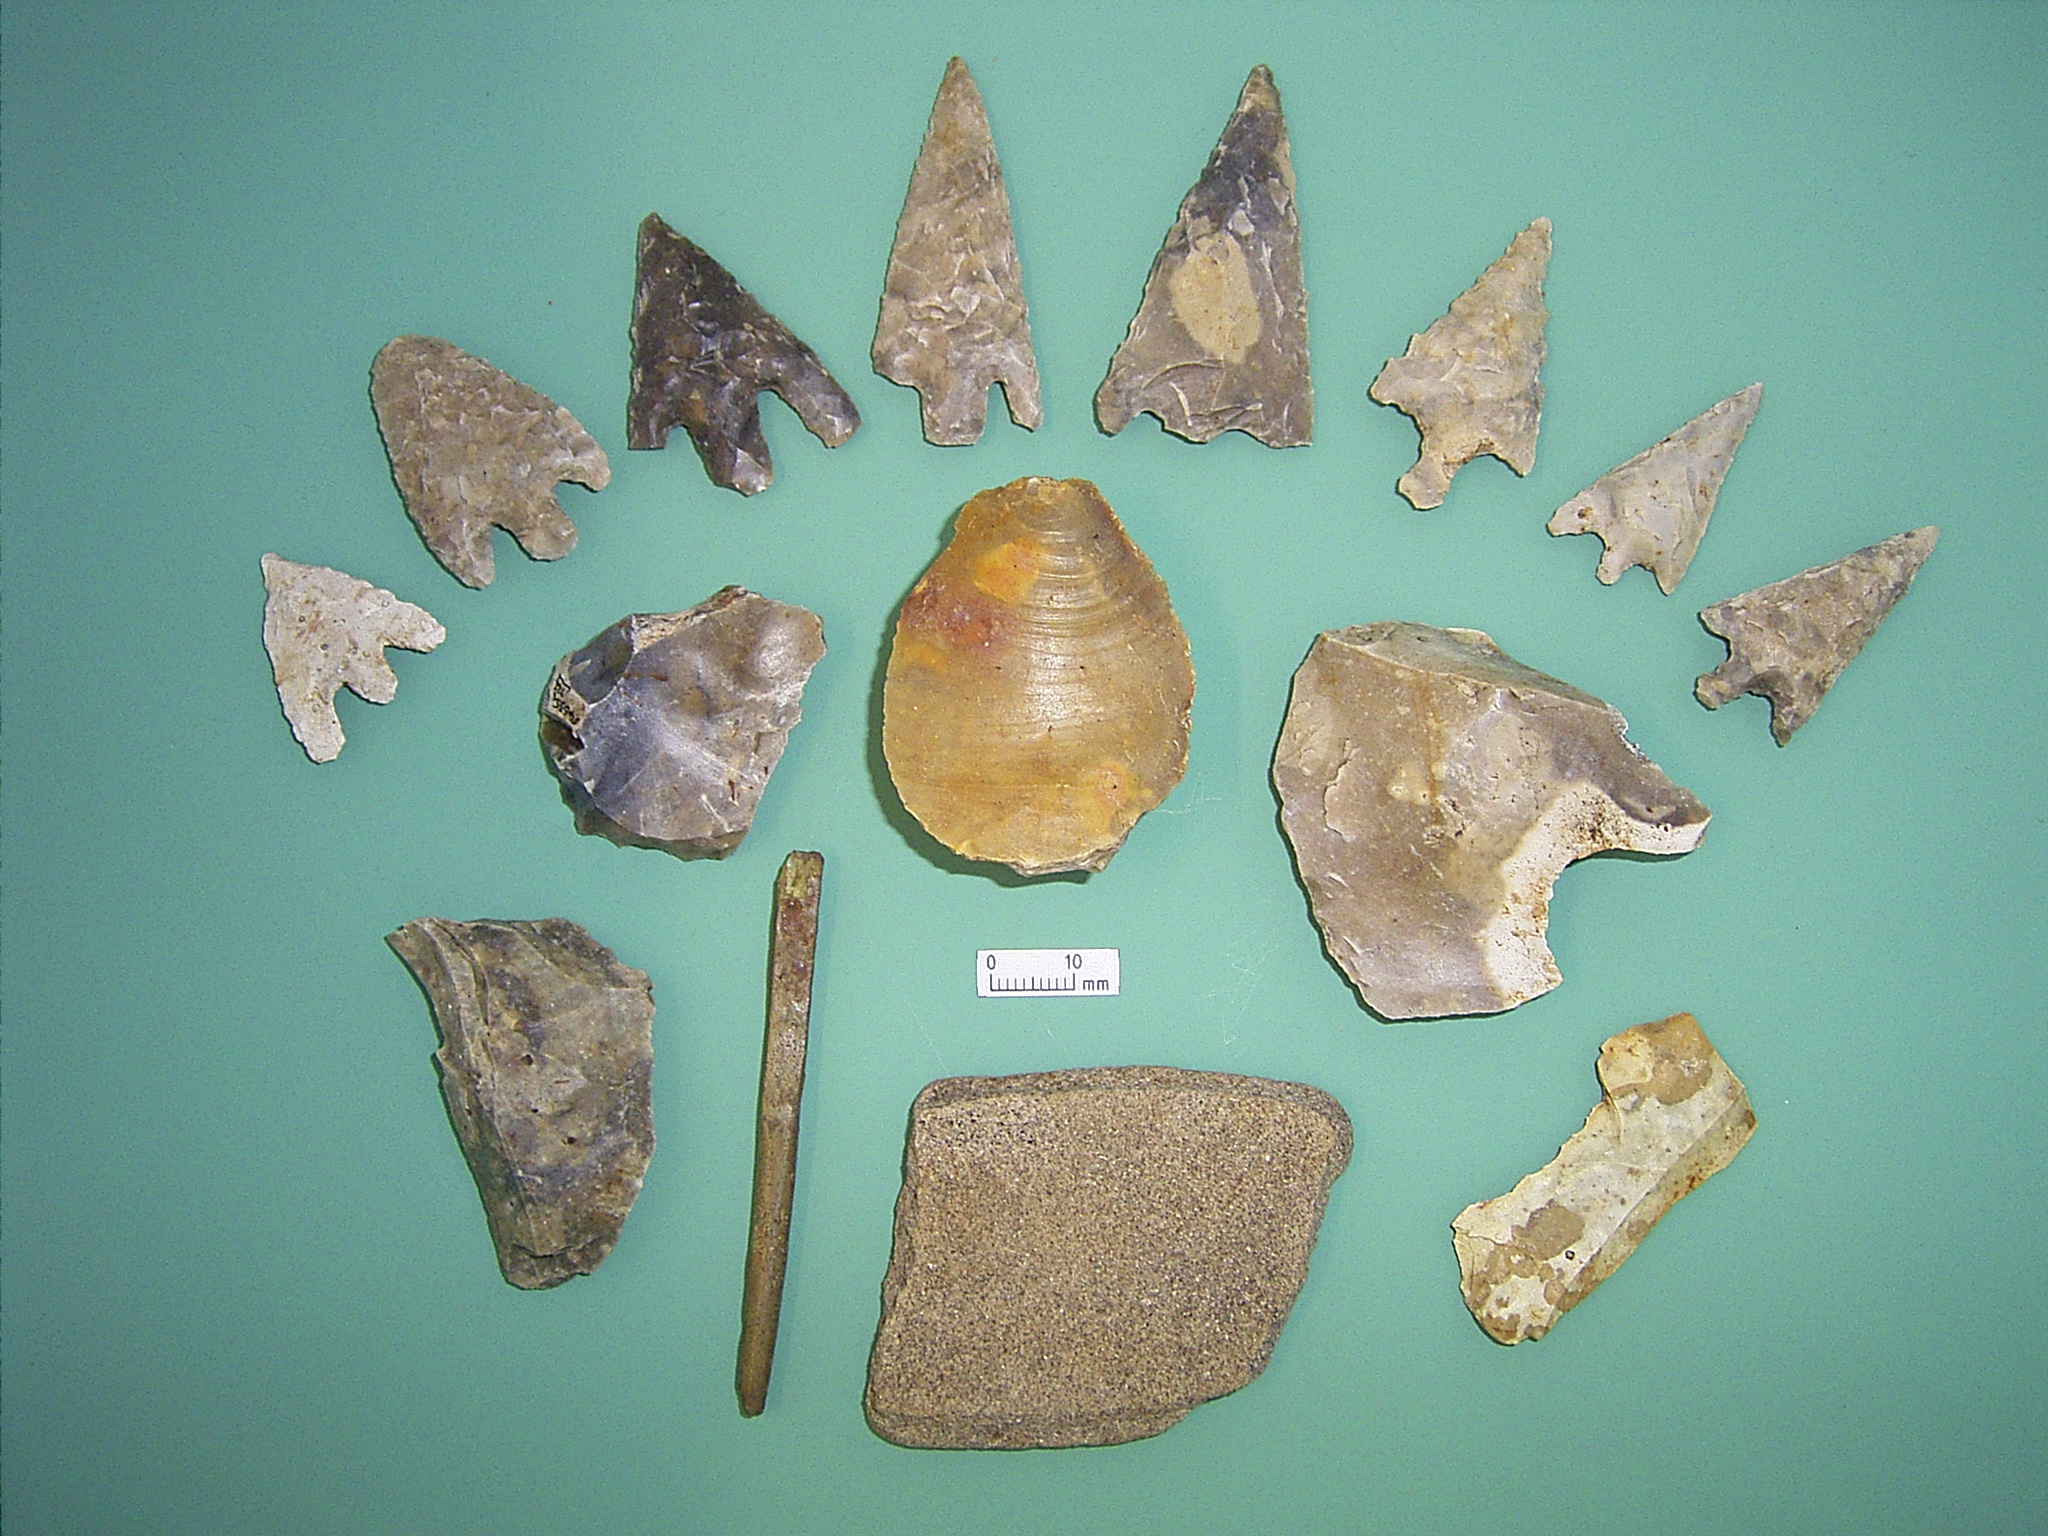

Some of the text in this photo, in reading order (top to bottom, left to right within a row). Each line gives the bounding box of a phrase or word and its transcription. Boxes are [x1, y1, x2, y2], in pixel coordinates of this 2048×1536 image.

[986, 953, 1083, 971] 0 10
[1082, 979, 1109, 991] mm
